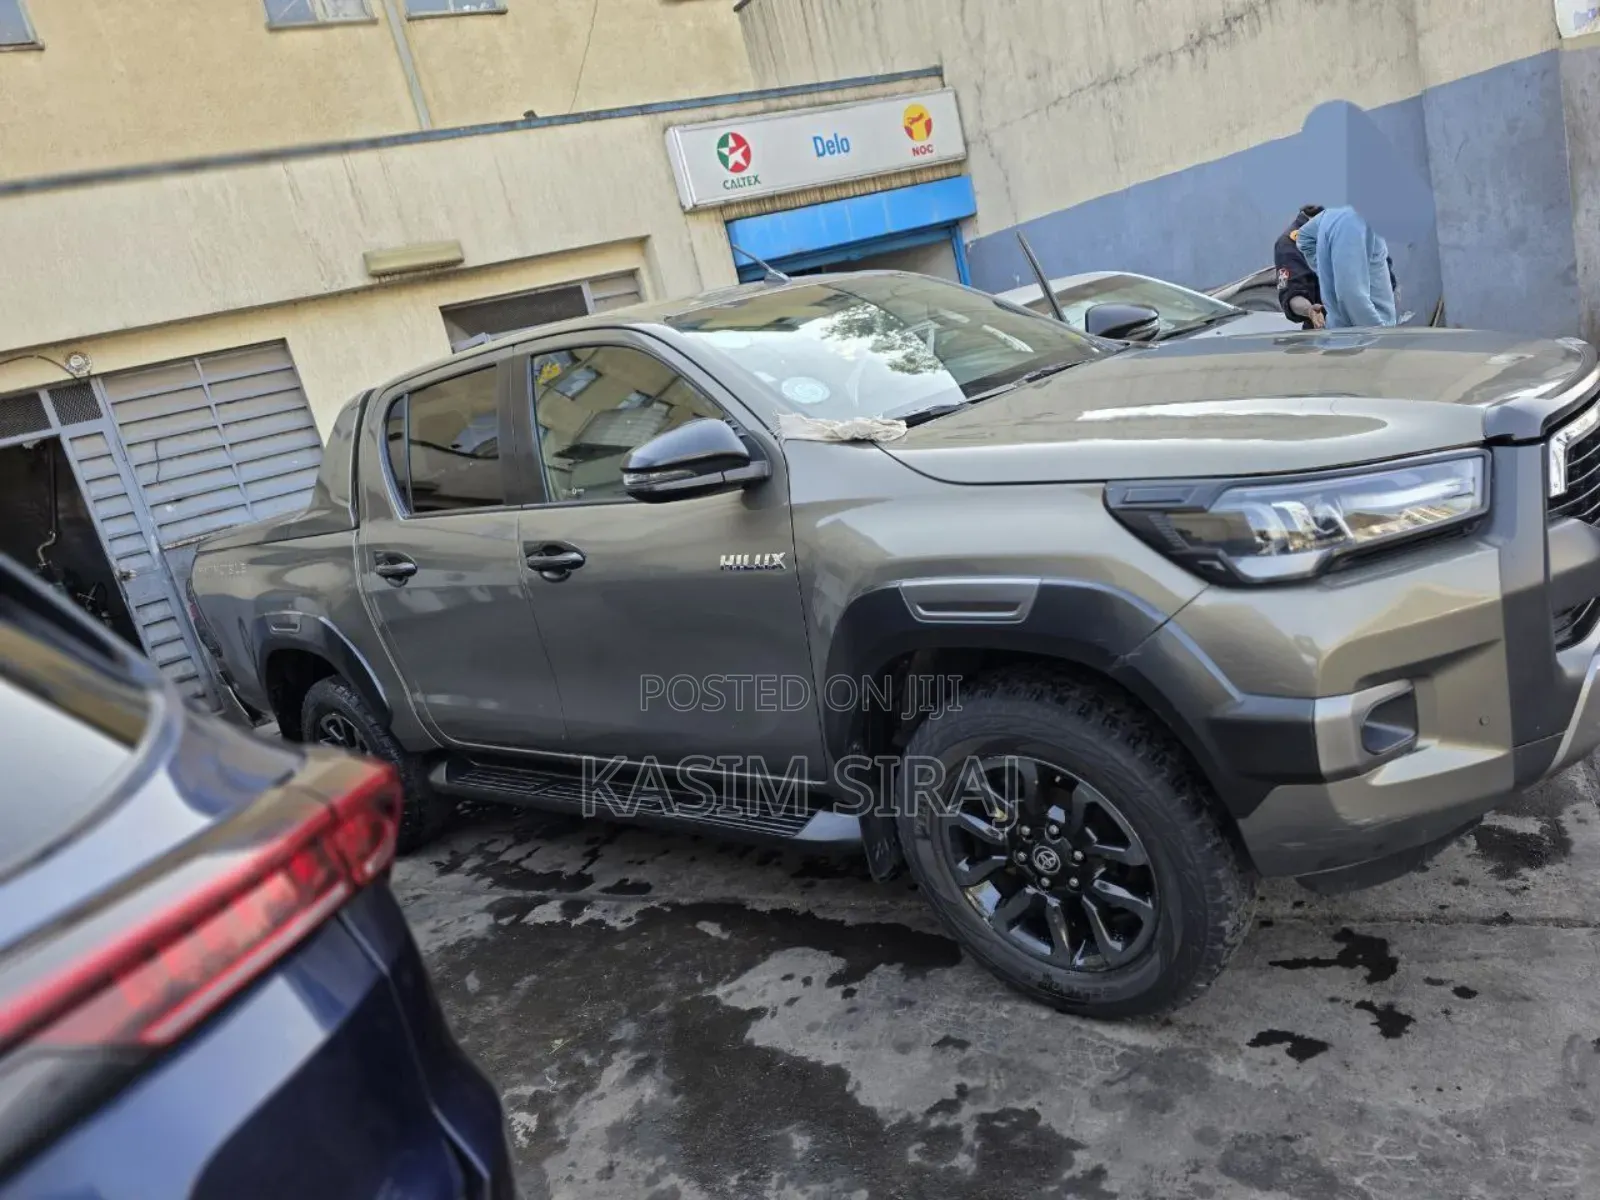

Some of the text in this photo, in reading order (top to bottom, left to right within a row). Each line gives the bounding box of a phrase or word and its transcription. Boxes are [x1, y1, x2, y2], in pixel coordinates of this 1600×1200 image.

[812, 132, 851, 157] Delo
[911, 143, 934, 157] NOC
[722, 174, 761, 191] CALTEX
[720, 552, 787, 570] HILUX
